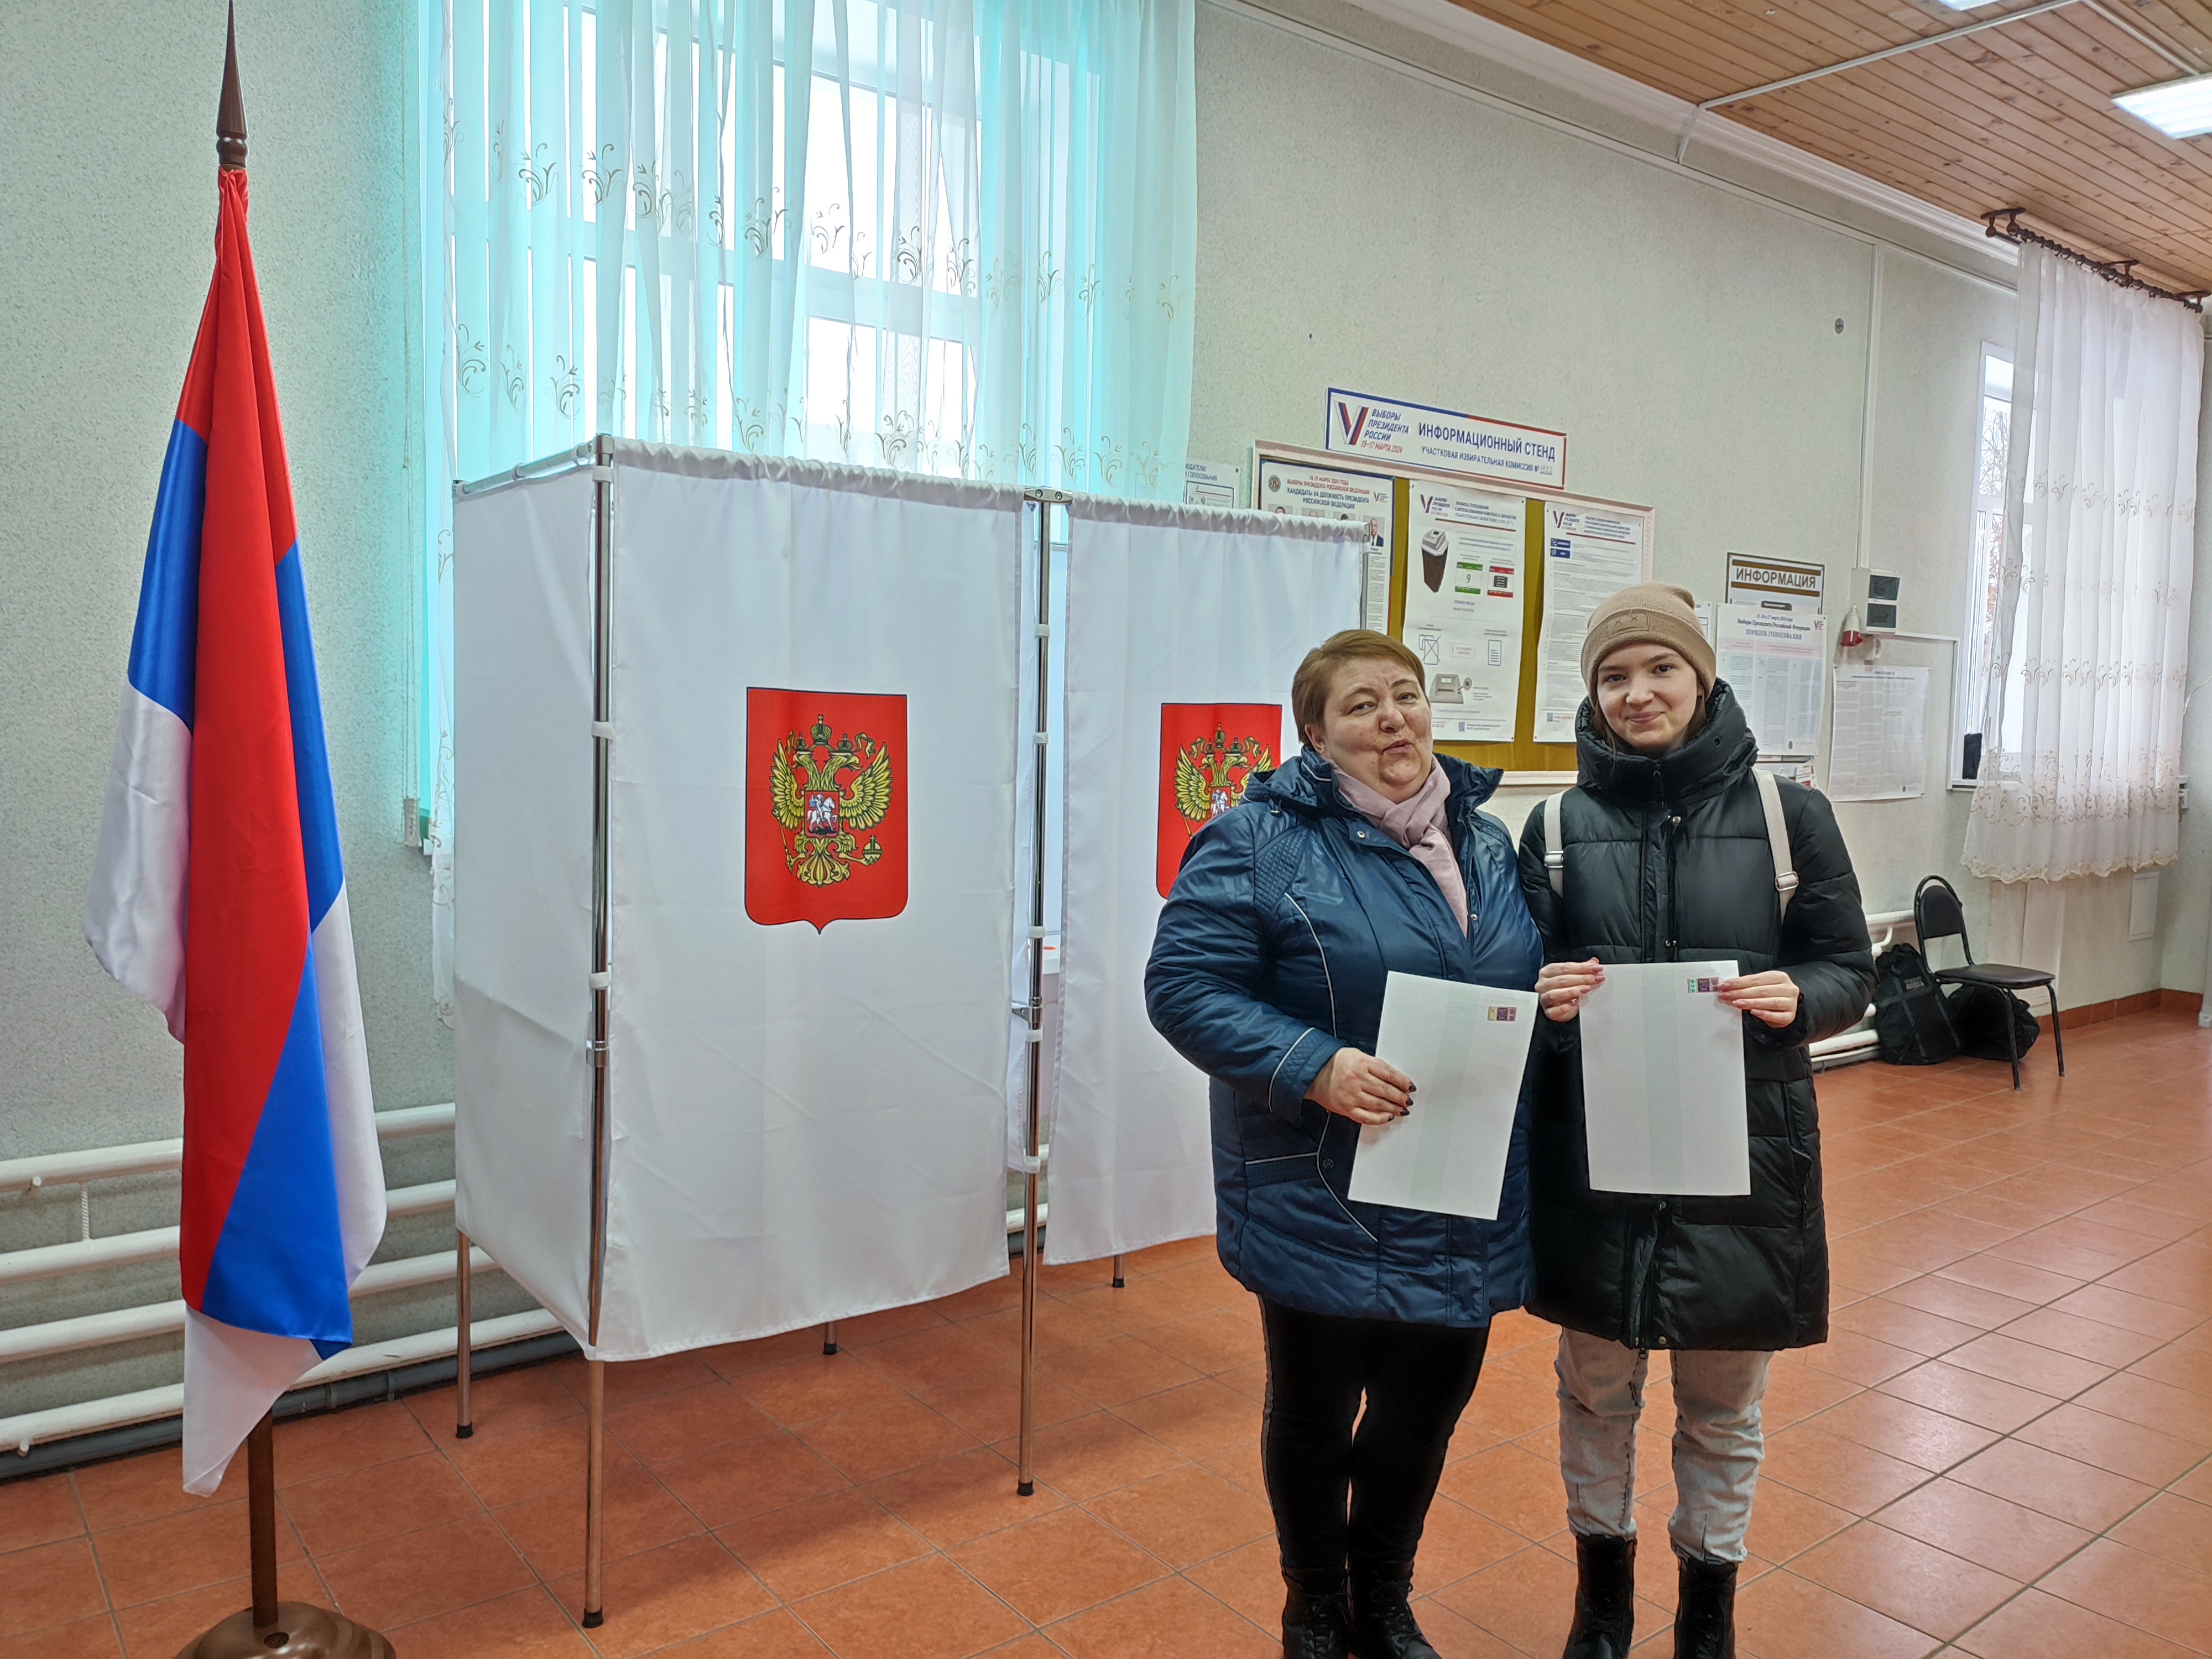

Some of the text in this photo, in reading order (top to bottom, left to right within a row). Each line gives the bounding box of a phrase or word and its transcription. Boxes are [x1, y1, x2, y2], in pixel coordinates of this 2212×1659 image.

[1372, 409, 1401, 421] ВЫБОРЫ
[1368, 419, 1409, 434] ПРЕЗИДЕНТА
[1364, 430, 1391, 442] РОССИИ
[1419, 422, 1556, 462] ИНФОРМАЦИОННЫЙ СТЕНД
[1375, 443, 1391, 452] МАРТА
[1391, 445, 1403, 453] 2024
[1422, 446, 1458, 460] УЧАСТКОВАЯ
[1459, 452, 1504, 467] ИЗБИРАТЕЛЬНАЯ
[1505, 460, 1533, 472] КОМИССИЯ
[1188, 472, 1217, 481] ГОЛОСОВАНИЯ
[1287, 487, 1313, 496] КАНДИДАТЫ
[1319, 491, 1344, 500] ДОЛЖНОСТЬ
[1345, 494, 1369, 503] ПРЕЗИДЕНТА
[1302, 497, 1355, 509] РОССИЙСКОЙ ФЕДЕРАЦИИ
[1736, 567, 1816, 588] ИНФОРМАЦИЯ
[1768, 631, 1802, 640] ГОЛОСОВАНИЯ
